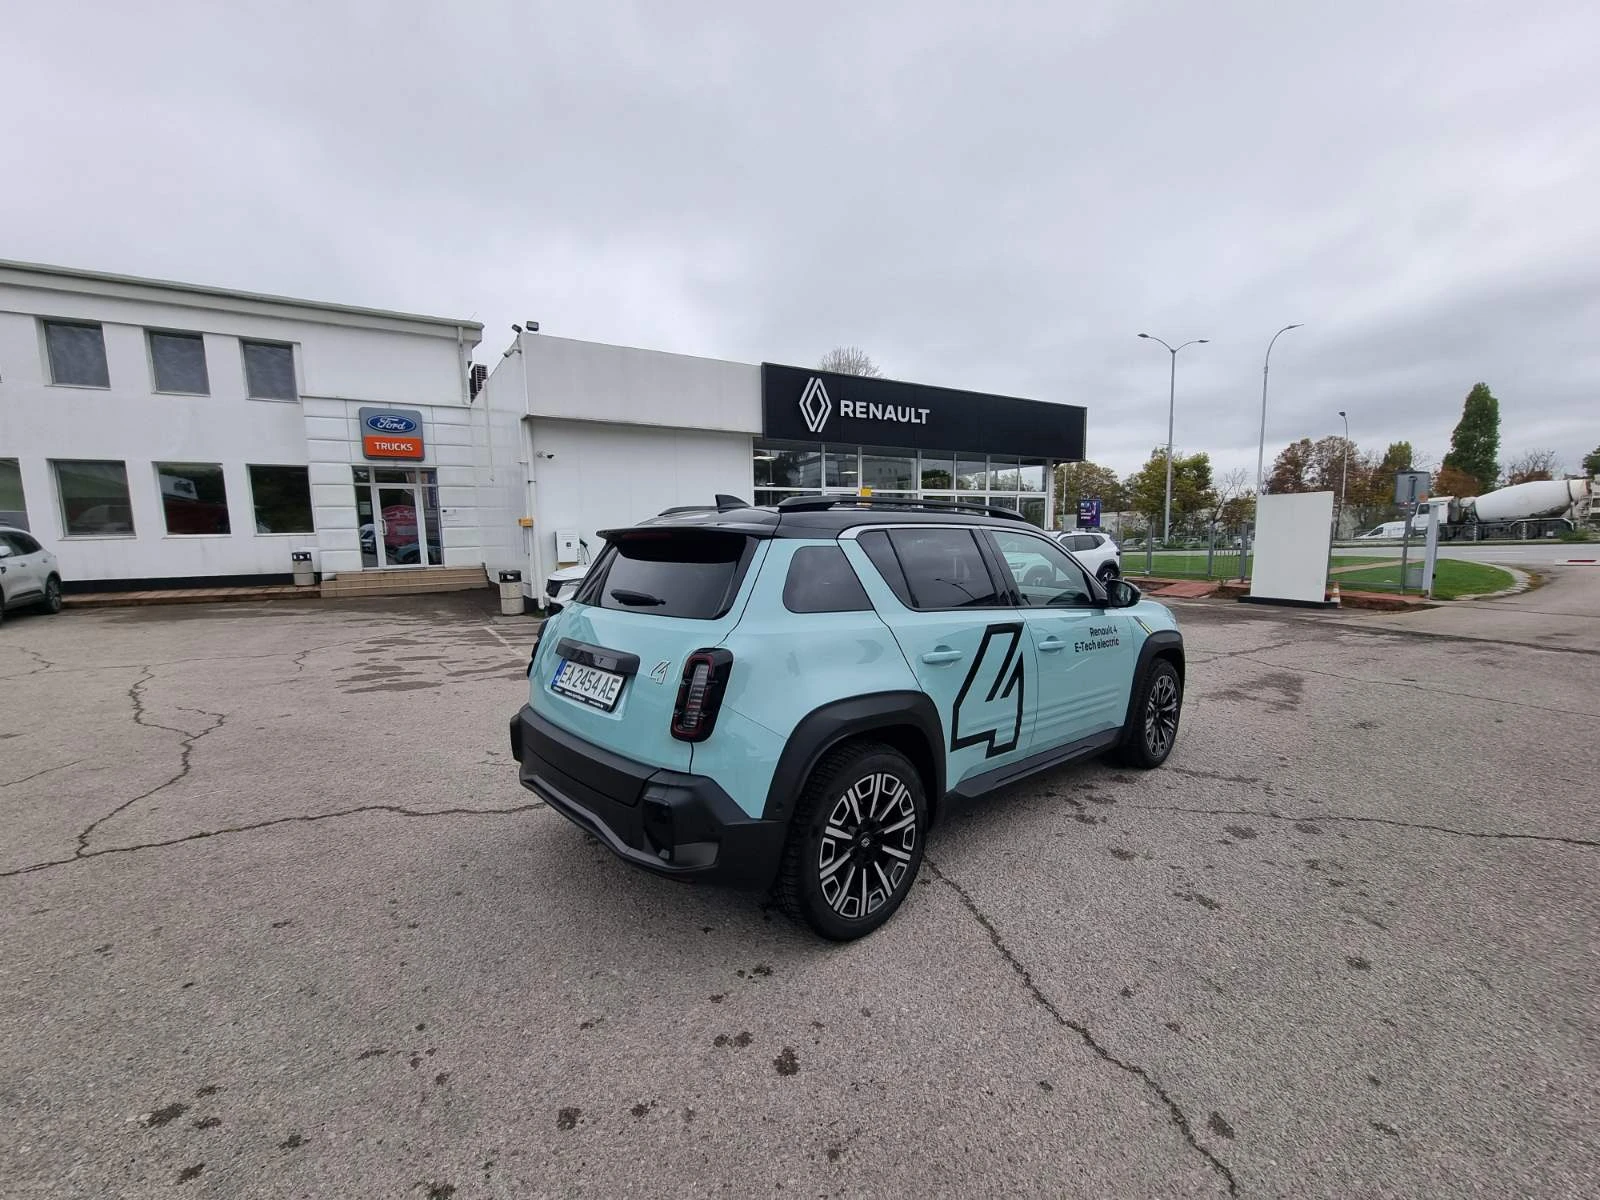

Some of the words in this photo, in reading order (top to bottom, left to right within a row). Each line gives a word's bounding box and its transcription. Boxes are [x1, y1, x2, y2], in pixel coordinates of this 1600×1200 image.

[840, 399, 930, 424] RENAULT
[377, 417, 407, 430] Ford
[375, 441, 413, 451] TRUCKS
[1089, 625, 1113, 637] Renault
[1113, 624, 1118, 635] 4
[1074, 639, 1097, 653] E-Tech
[1097, 638, 1120, 649] electric
